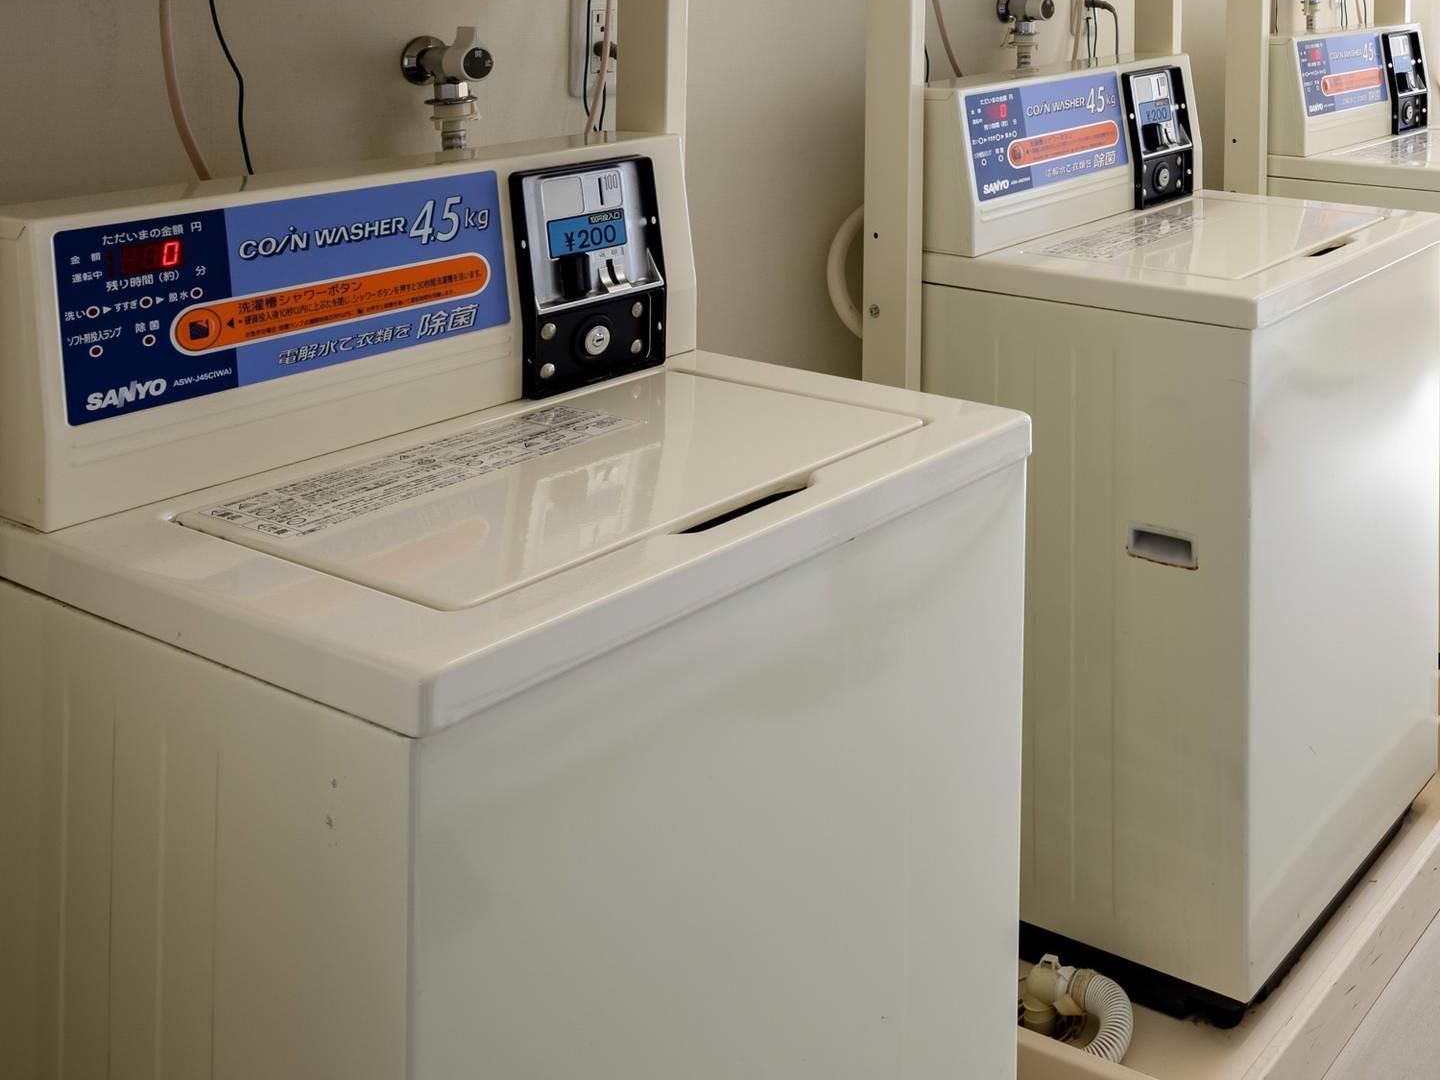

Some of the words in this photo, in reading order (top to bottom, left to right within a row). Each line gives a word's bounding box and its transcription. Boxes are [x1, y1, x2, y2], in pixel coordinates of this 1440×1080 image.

[1052, 97, 1085, 112] WASHER
[603, 174, 618, 190] 100
[983, 179, 1009, 194] SANYO
[102, 224, 184, 246] ただいまの金額
[190, 221, 202, 233] 円
[239, 225, 307, 260] COIN
[314, 216, 406, 247] WASHER
[464, 208, 489, 230] kg
[565, 224, 617, 251] ¥200
[162, 240, 180, 266] 0
[71, 270, 103, 283] 運転中
[195, 265, 206, 276] 分
[168, 291, 189, 303] 脱水
[238, 281, 363, 314] 洗濯槽シャワーボタン
[114, 299, 138, 313] すすぎ
[64, 311, 86, 321] 洗い
[135, 320, 160, 334] 除菌
[279, 322, 411, 365] 電解水で衣類を
[416, 304, 480, 340] 除菌
[86, 378, 167, 411] SANYO
